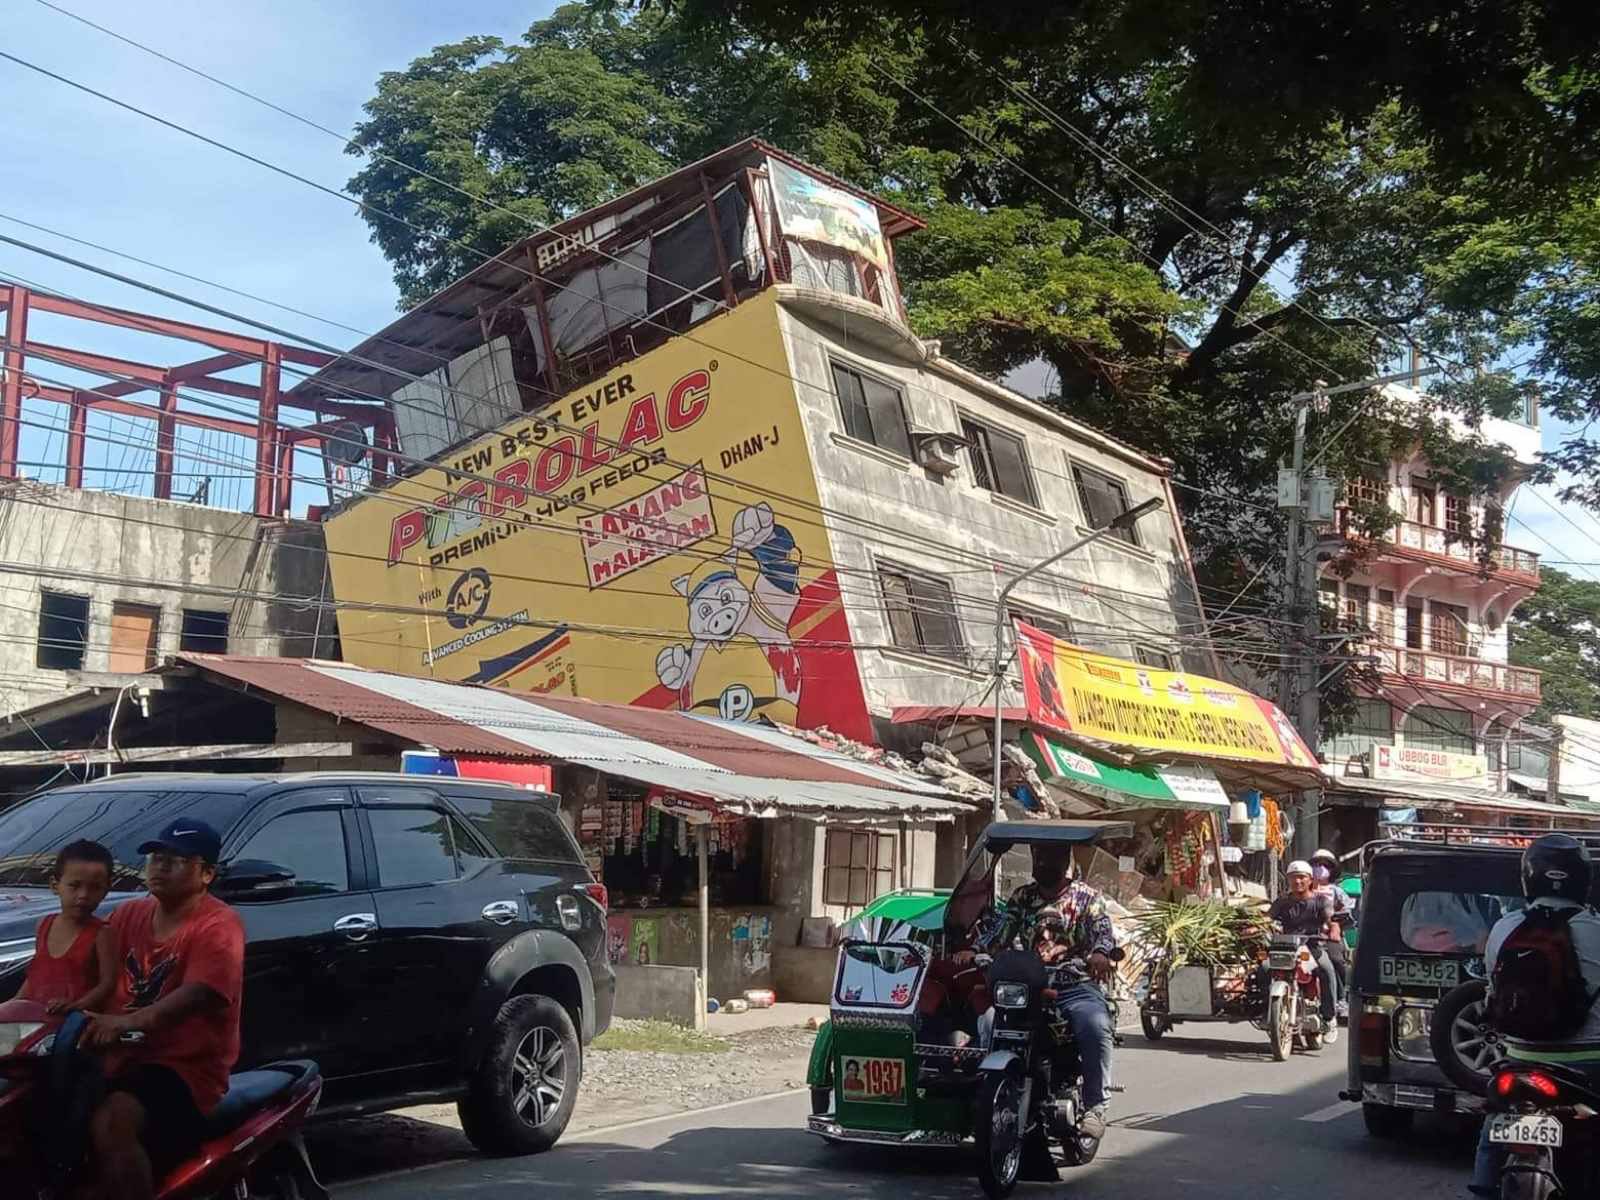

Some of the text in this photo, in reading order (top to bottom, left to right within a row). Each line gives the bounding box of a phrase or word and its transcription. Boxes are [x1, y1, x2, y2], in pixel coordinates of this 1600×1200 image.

[446, 374, 635, 486] NEW BEST EVER
[720, 426, 780, 469] DHAN-J
[387, 369, 711, 568] PIGROLAC
[583, 471, 700, 547] LAMANG
[418, 584, 482, 610] With A/C
[464, 624, 497, 646] COOLING
[864, 1060, 903, 1095] 1937
[1515, 1125, 1557, 1143] 18453
